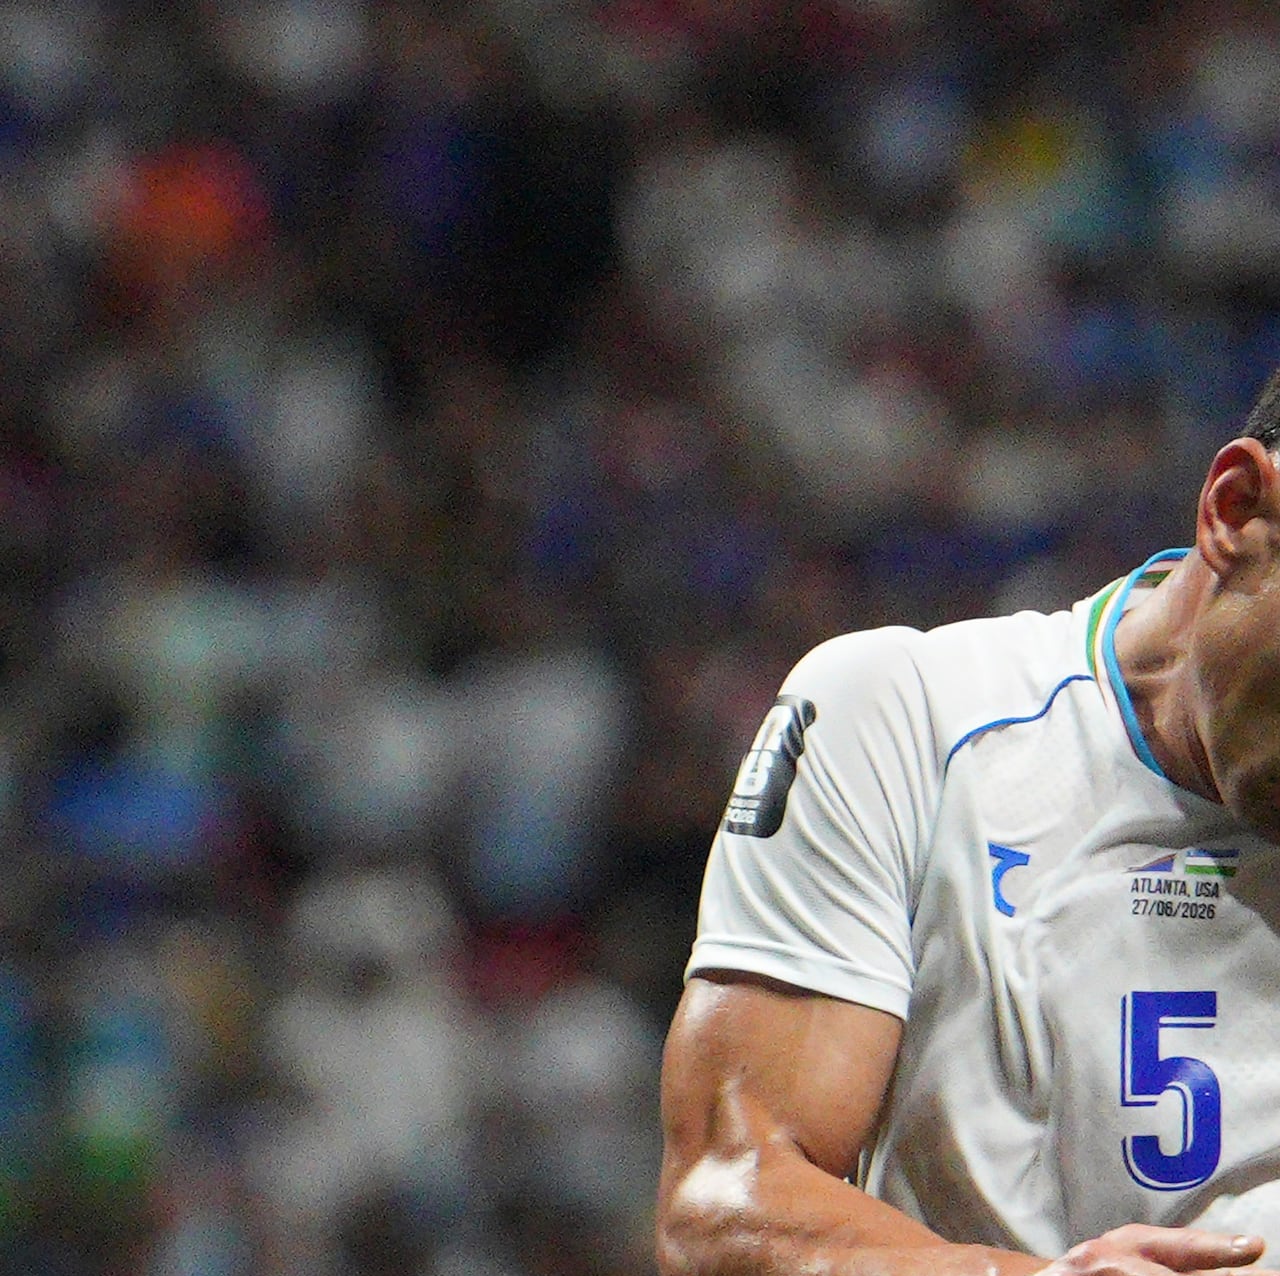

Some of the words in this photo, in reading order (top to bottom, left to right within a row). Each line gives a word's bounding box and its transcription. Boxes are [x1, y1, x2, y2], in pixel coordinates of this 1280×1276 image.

[1131, 878, 1190, 897] ATLANTA,
[1195, 881, 1219, 898] USA
[1132, 899, 1216, 919] 27/06/2026
[1121, 991, 1221, 1192] 5
